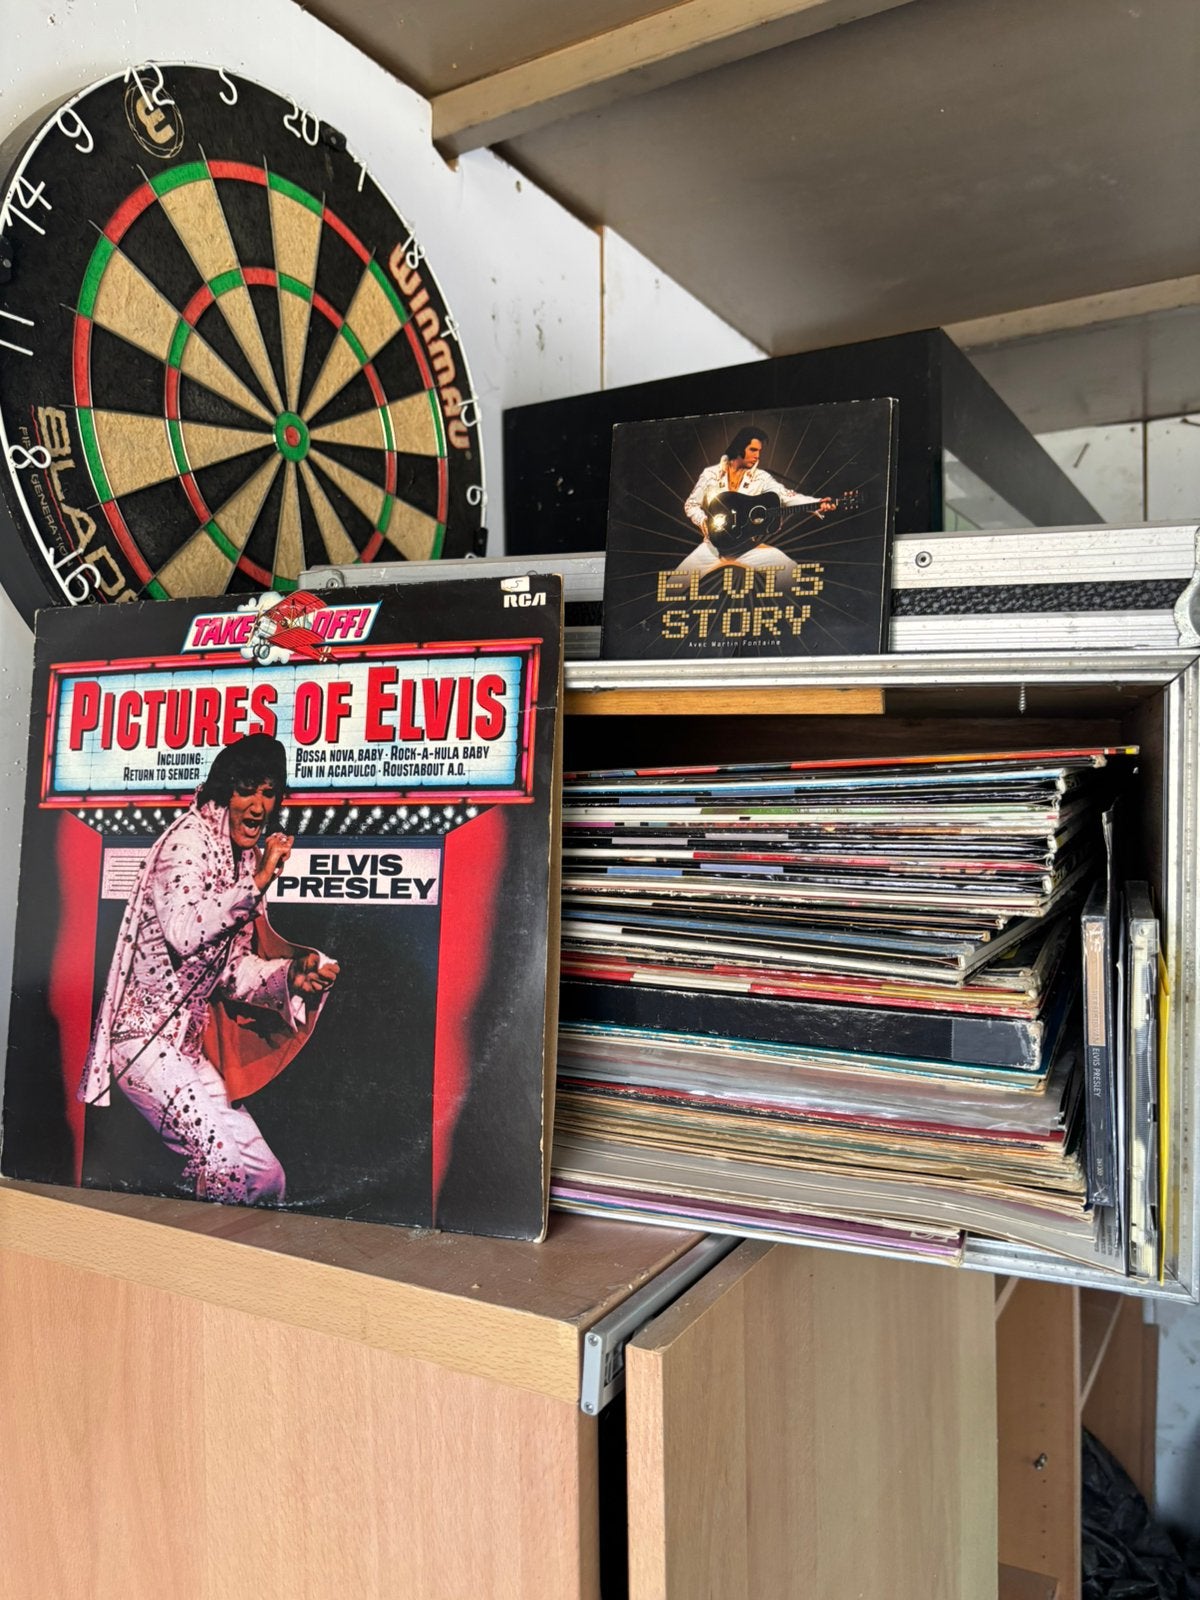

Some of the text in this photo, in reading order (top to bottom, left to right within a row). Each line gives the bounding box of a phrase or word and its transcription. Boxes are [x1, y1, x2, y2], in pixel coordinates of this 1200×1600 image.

[124, 61, 175, 111] 12
[56, 107, 94, 153] 9
[283, 95, 319, 146] 20
[8, 444, 52, 470] 8
[48, 547, 101, 603] 16
[656, 562, 825, 602] ELVIS
[503, 592, 547, 608] RCA
[192, 607, 372, 647] TAKE OFF!
[661, 604, 812, 639] STORY
[742, 639, 781, 647] Fontaine
[69, 666, 508, 752] PICTURES OF ELVIS
[157, 751, 204, 766] INCLUDING:
[296, 748, 326, 762] BOSSA
[390, 745, 459, 760] ROCK-A-HULA
[462, 746, 490, 759] BABY
[123, 767, 200, 781] RETURN TO SENDER
[295, 763, 313, 778] FUN
[316, 766, 325, 777] IN
[328, 764, 376, 778] ACAPULCO
[383, 761, 445, 777] ROUSTABOUT
[309, 853, 403, 877] ELVIS
[276, 876, 437, 901] PRESLEY
[1092, 1047, 1101, 1066] ELVIS
[1092, 1067, 1102, 1098] PRESLEY
